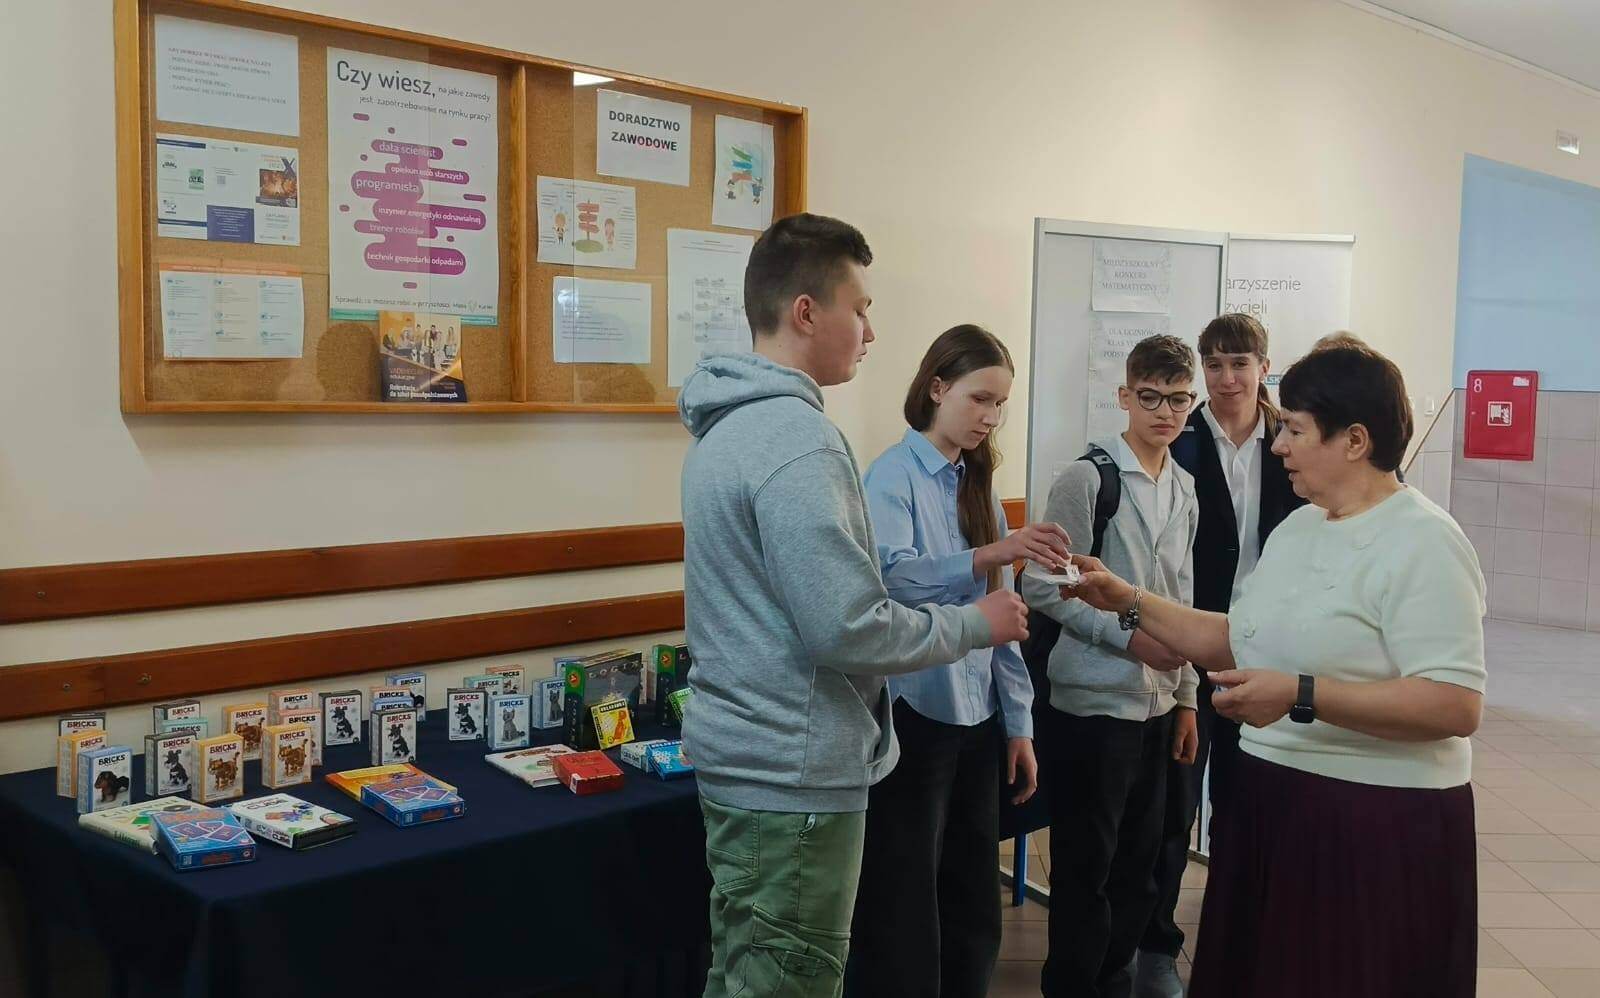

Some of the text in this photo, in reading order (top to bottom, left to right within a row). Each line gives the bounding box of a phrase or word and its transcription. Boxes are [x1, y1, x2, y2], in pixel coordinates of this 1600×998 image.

[337, 60, 372, 91] Czy
[378, 70, 436, 98] wiesz,
[448, 87, 464, 96] jakie
[465, 90, 490, 102] zawody
[359, 95, 374, 104] jest
[438, 106, 447, 114] na
[448, 109, 468, 119] rynku
[608, 110, 681, 132] DORADZTWO
[611, 131, 678, 151] ZAWODOWE
[379, 142, 437, 158] data scientist
[434, 168, 463, 181] starszych
[355, 178, 419, 193] programista
[369, 223, 394, 233] trener
[367, 251, 464, 267] technik gospodarki odpadami
[1114, 271, 1147, 280] KONKURS
[1226, 274, 1301, 294] arzyszenie
[1473, 378, 1482, 393] 8
[284, 694, 308, 703] BRICKS
[331, 696, 356, 705] BRICKS
[379, 691, 404, 699] BRICKS
[236, 709, 262, 719] BRICKS
[289, 715, 316, 724] BRICKS
[387, 714, 412, 722] BRICKS
[67, 720, 97, 729] BRICKS
[280, 730, 306, 741] BRICKS
[80, 736, 103, 748] BRICKS
[163, 737, 191, 749] BRICKS
[210, 742, 237, 754] BRICKS
[98, 753, 126, 766] BRICKS
